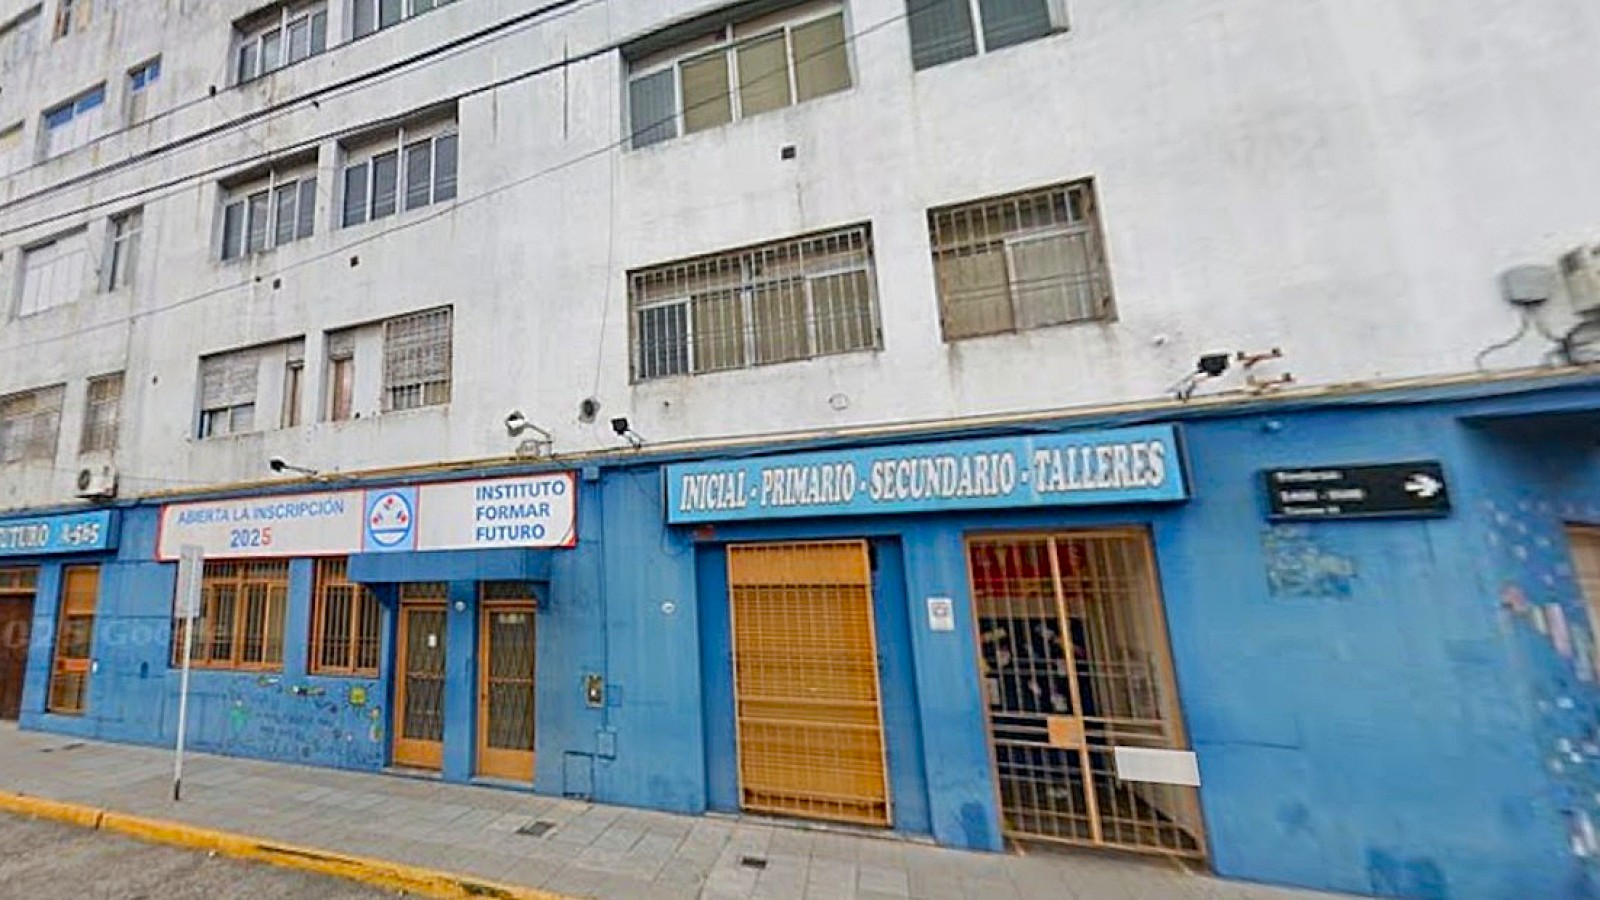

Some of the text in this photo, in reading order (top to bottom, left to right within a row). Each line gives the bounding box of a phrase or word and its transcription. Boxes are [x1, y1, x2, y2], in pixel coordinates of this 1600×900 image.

[680, 471, 747, 511] INICIAL
[760, 461, 856, 507] PRIMARIO
[870, 452, 1016, 500] SECUNDARIO
[1033, 441, 1165, 492] TALLERES
[476, 480, 565, 500] INSTITUTO
[178, 499, 344, 524] ABIERTA LA INSCRIPCIÓN
[476, 503, 550, 520] FORMAR
[231, 527, 272, 547] 2025
[476, 524, 545, 541] FUTURO
